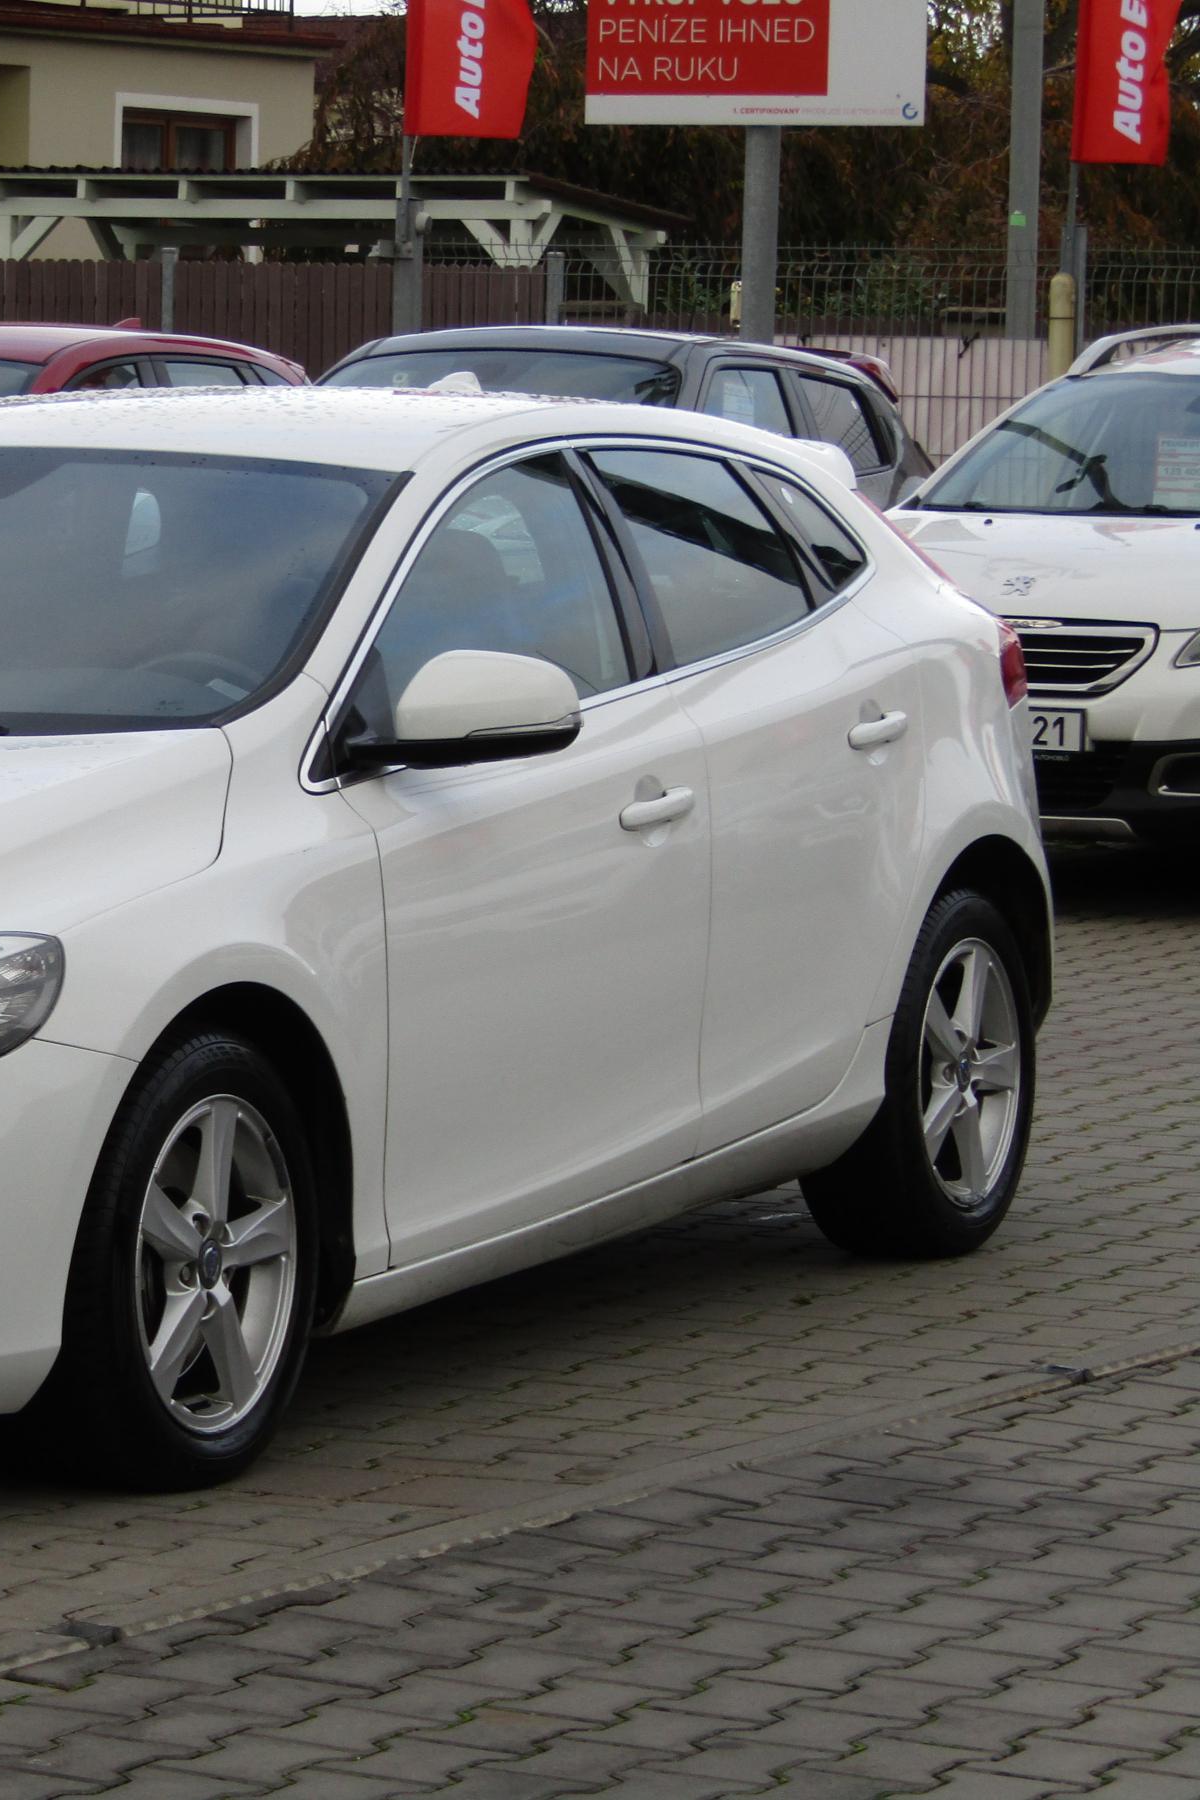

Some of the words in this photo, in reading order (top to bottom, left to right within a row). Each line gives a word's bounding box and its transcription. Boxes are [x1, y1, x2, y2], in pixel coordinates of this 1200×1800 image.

[599, 14, 708, 44] PENÍZE
[719, 18, 815, 44] IHNED
[454, 11, 485, 119] Auto
[598, 56, 643, 82] NA
[653, 56, 739, 82] RUKU
[1113, 30, 1146, 145] Auto
[1032, 716, 1065, 747] 21
